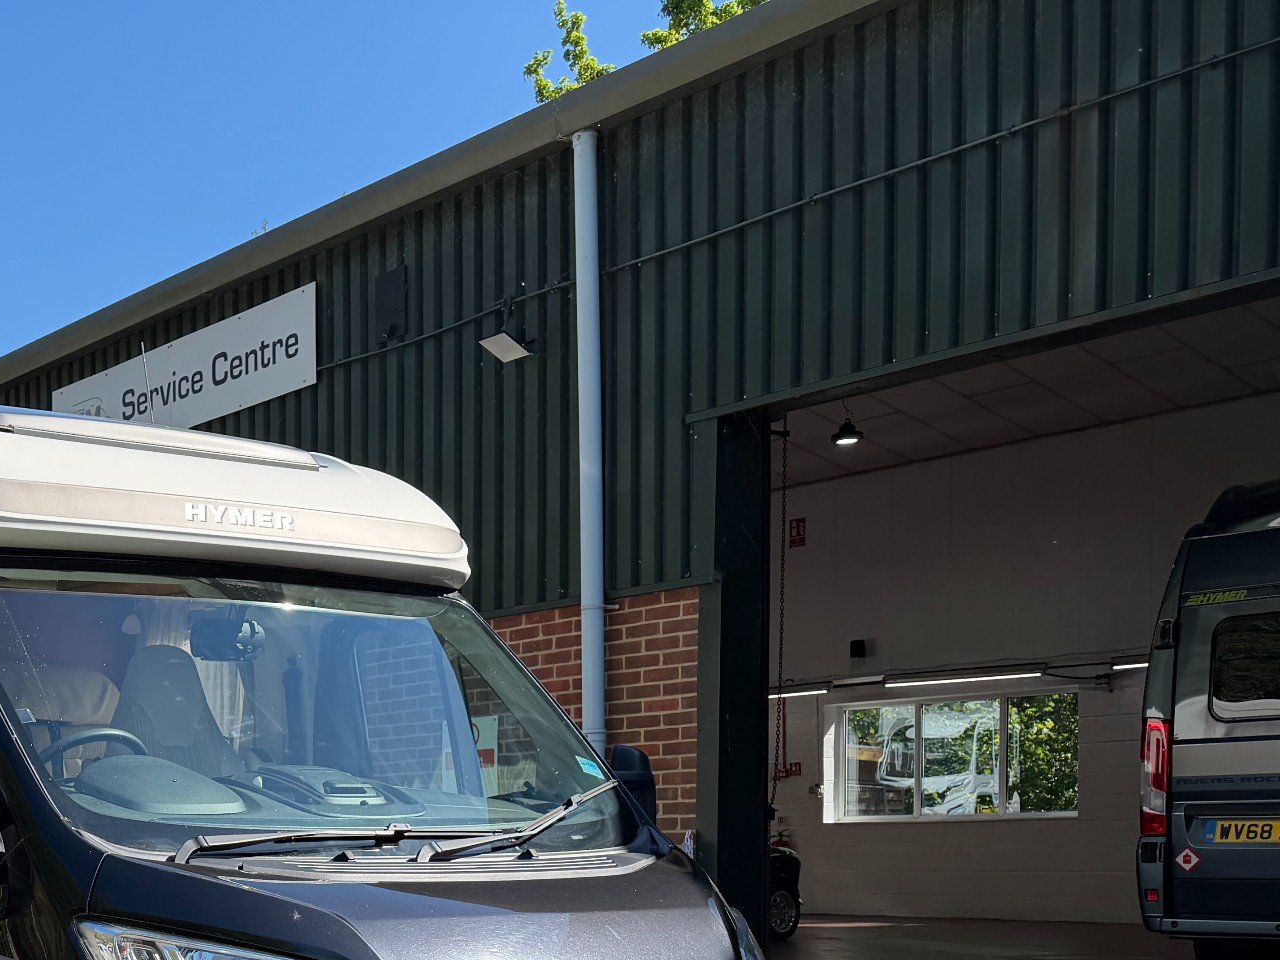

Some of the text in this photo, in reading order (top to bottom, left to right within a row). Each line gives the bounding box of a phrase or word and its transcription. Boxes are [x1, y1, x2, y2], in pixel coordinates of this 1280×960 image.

[122, 332, 299, 420] Service Centre
[184, 501, 295, 531] HYMER
[1197, 589, 1248, 603] HYMER
[1220, 823, 1274, 840] WV68
